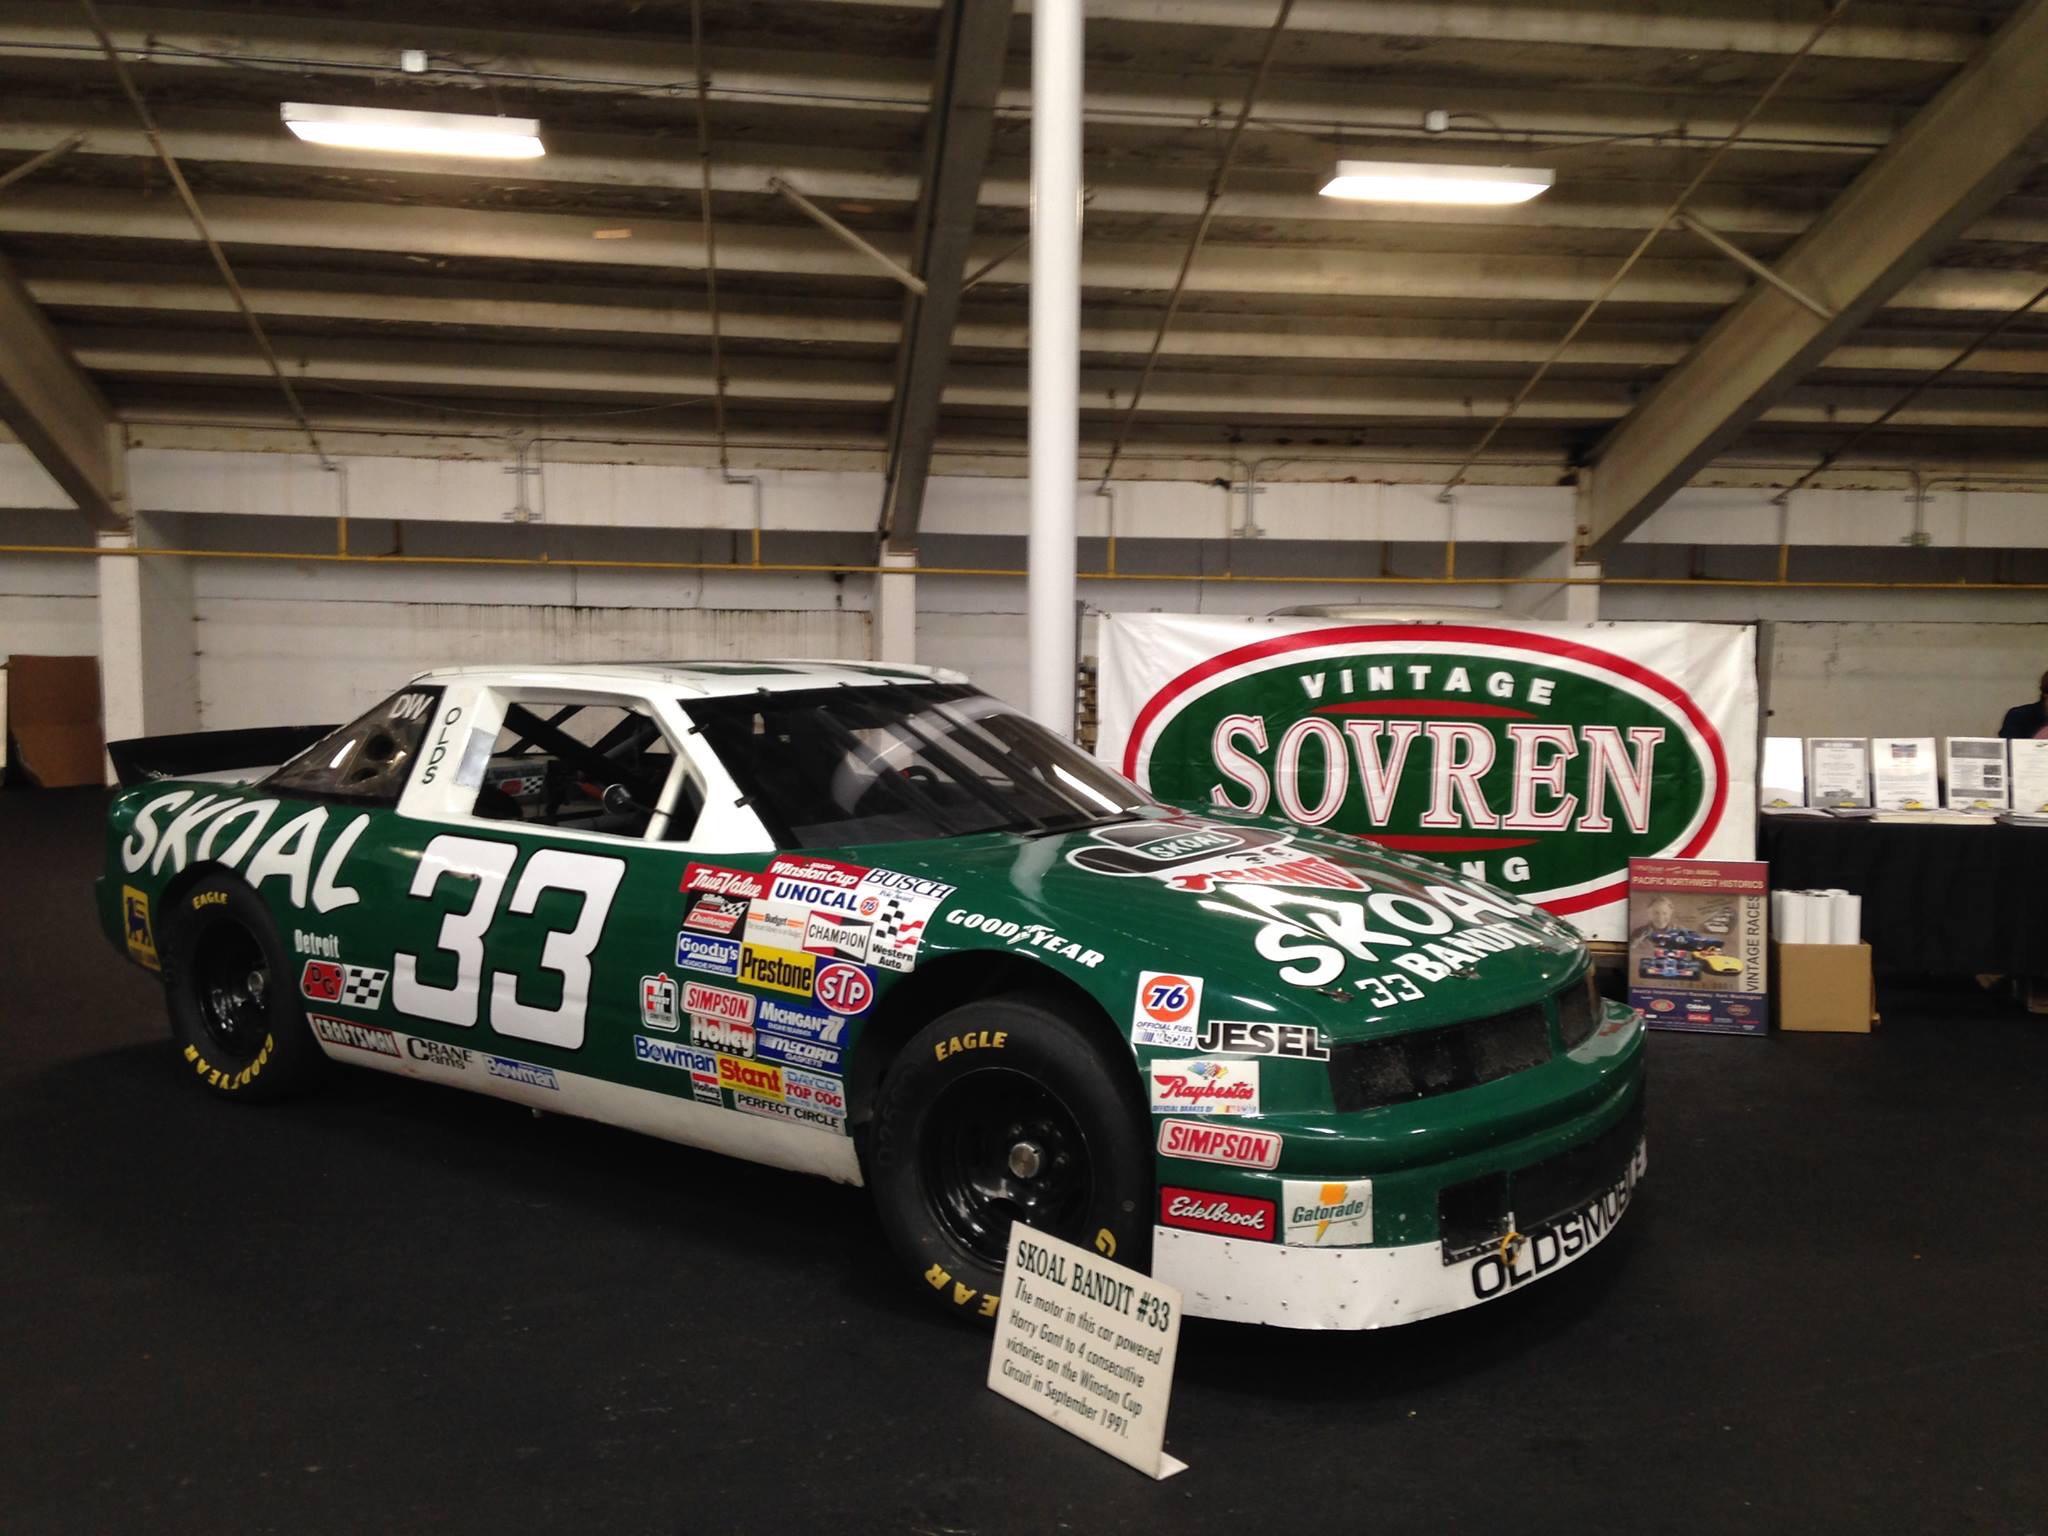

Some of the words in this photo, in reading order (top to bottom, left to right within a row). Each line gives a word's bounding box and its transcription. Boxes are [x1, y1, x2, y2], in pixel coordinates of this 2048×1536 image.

[1299, 664, 1556, 706] VINTAGE
[388, 693, 435, 720] DW
[1210, 714, 1665, 834] SOVREN
[121, 790, 371, 914] SKOAL
[1150, 831, 1232, 859] SKOAL
[770, 861, 826, 881] Winston
[825, 868, 860, 887] Cup
[863, 868, 953, 899] BUSCH
[1631, 876, 1665, 886] PACIFIC
[1666, 878, 1718, 888] NORTHWEST
[1719, 880, 1764, 889] HISTORICS
[192, 891, 229, 911] EAGLE
[775, 881, 859, 912] UNOCAL
[862, 900, 877, 911] 76
[764, 912, 788, 927] Budget
[1747, 896, 1760, 936] RACES
[293, 929, 341, 958] Detroit
[392, 834, 626, 1050] 33
[680, 937, 739, 961] Goody's
[808, 924, 867, 949] CHAMPION
[1253, 880, 1538, 987] SKOAL
[740, 947, 812, 991] Prestone
[871, 943, 913, 962] Western
[878, 956, 902, 970] Auto
[1390, 922, 1544, 982] BANDIT
[1746, 939, 1760, 992] VINTAGE
[687, 987, 750, 1019] SIMPSON
[822, 970, 866, 1005] STP
[1151, 986, 1187, 1009] 76
[1353, 973, 1426, 1009] 33
[759, 1000, 821, 1031] MICHIGAN
[1136, 1021, 1171, 1031] OFFICIAL
[1173, 1024, 1194, 1033] FUEL
[315, 1018, 399, 1056] CRAFTSMAN
[693, 1015, 754, 1058] Holley
[934, 1030, 1008, 1062] EAGLE
[1197, 1021, 1331, 1059] JESEL
[636, 1035, 717, 1074] Bowman
[485, 1055, 559, 1089] Bowman
[719, 1057, 782, 1093] Stant
[694, 1082, 720, 1098] Holley
[785, 1083, 812, 1100] TOP
[814, 1091, 842, 1108] COG
[1154, 1075, 1254, 1105] Raybestos
[737, 1094, 792, 1116] PERFECT
[794, 1108, 839, 1129] CIRCLE
[1167, 1126, 1271, 1163] SIMPSON
[1167, 1196, 1266, 1230] Edelbrock
[1292, 1200, 1365, 1224] Gatorade
[1016, 1240, 1068, 1288] SKOAL
[1071, 1263, 1135, 1316] BANDIT
[1135, 1291, 1171, 1333] #33
[1014, 1276, 1033, 1305] The
[1033, 1296, 1064, 1319] motor
[1064, 1306, 1076, 1324] in
[1076, 1311, 1097, 1334] this
[1097, 1325, 1115, 1342] car
[1114, 1334, 1164, 1366] powered
[1008, 1309, 1039, 1338] Harry
[1039, 1323, 1064, 1347] Gant
[1064, 1337, 1076, 1354] to
[1077, 1342, 1087, 1359] 4
[1086, 1350, 1145, 1389] consecutive
[1006, 1336, 1045, 1366] victories
[1045, 1358, 1060, 1375] on
[1060, 1360, 1079, 1384] the
[1079, 1369, 1121, 1404] Winston
[1121, 1391, 1144, 1419] Cup
[1002, 1358, 1032, 1387] Circuit
[1032, 1374, 1044, 1393] in
[1044, 1380, 1098, 1422] September
[1099, 1408, 1129, 1440] 1991.
